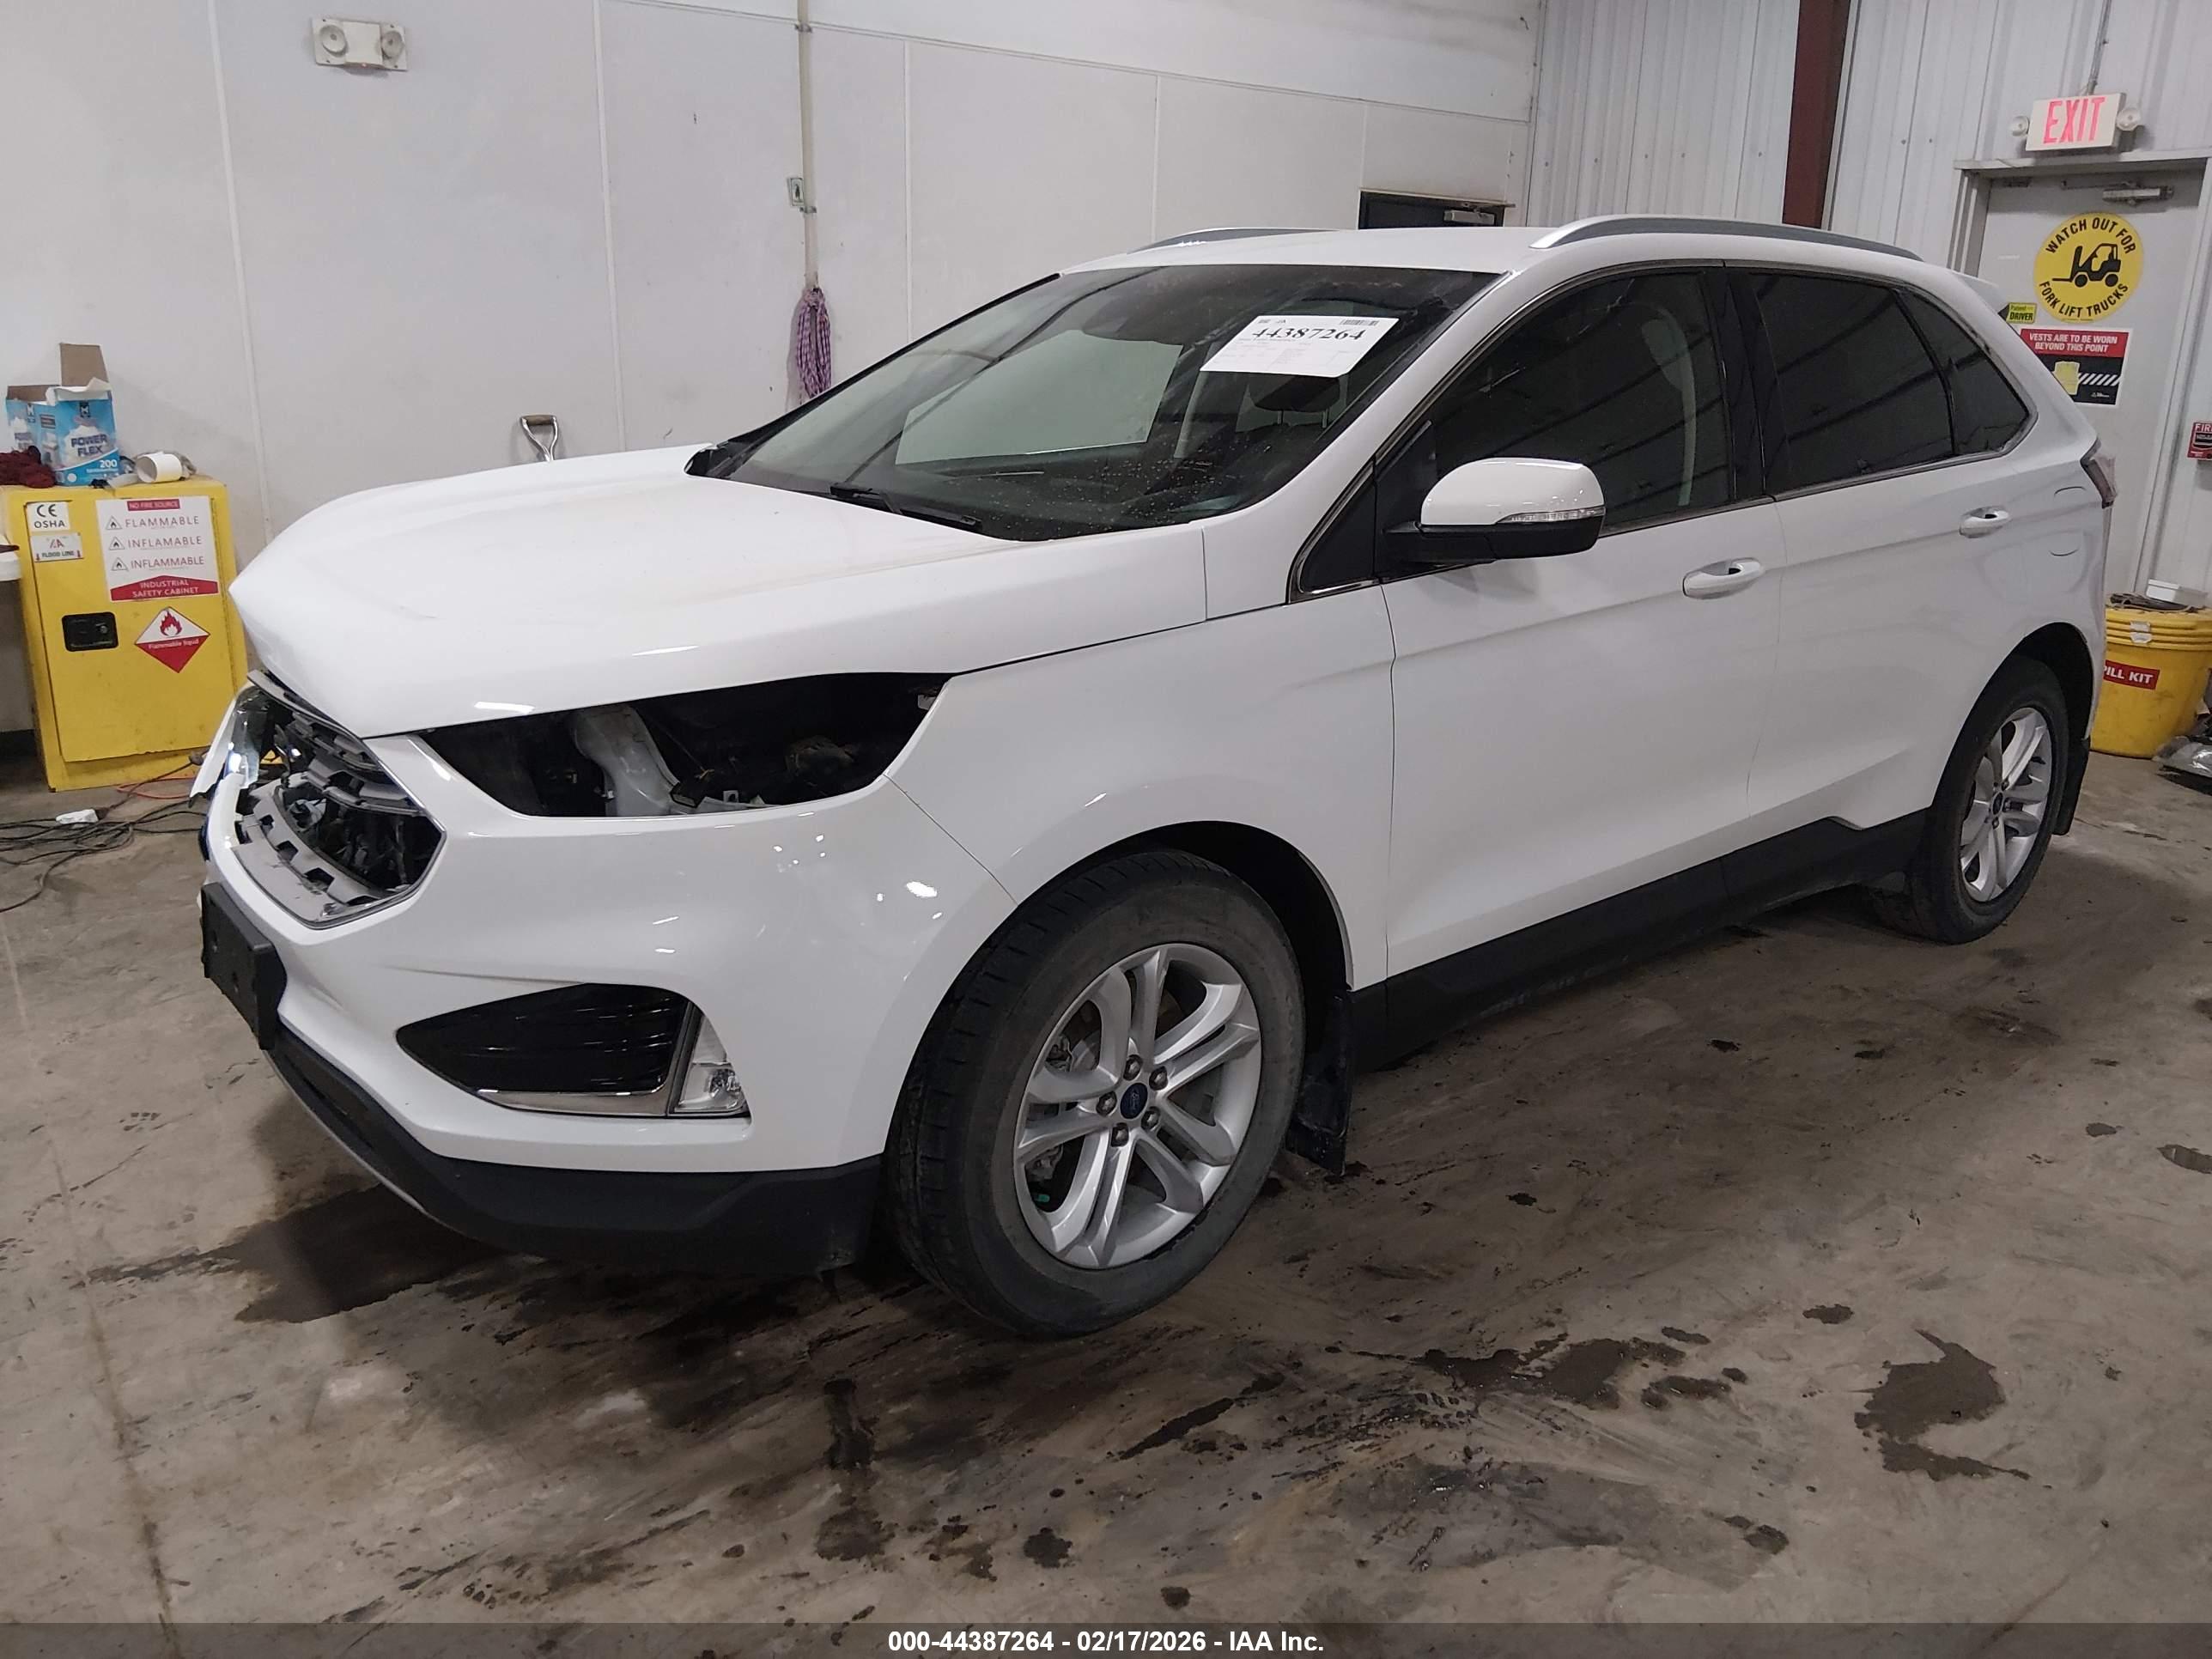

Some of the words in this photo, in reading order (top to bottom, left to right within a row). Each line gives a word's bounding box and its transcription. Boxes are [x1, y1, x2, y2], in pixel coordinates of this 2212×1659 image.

[2043, 96, 2106, 144] EXIT
[2045, 218, 2087, 253] WATCH
[2092, 216, 2118, 233] OUT
[2115, 228, 2136, 254] FOR
[2039, 281, 2061, 309] FORK
[2059, 302, 2083, 318] LIFT
[2086, 283, 2129, 317] TRUCKS
[2009, 312, 2033, 321] DRIVER
[1252, 327, 1367, 341] 44387264
[2029, 332, 2053, 342] VESTS
[2053, 334, 2069, 343] ARE
[2081, 335, 2092, 343] BE
[2093, 336, 2118, 344] WORN
[2034, 342, 2065, 351] BEYOND
[2067, 343, 2083, 352] THIS
[2084, 344, 2109, 353] POINT
[71, 434, 107, 447] POWER
[78, 446, 103, 457] FLEX
[100, 459, 118, 468] 200
[33, 520, 65, 529] OSHA
[125, 515, 200, 528] FLAMMABLE
[127, 535, 203, 548] INFLAMABLE
[131, 556, 205, 569] INFLAMMABLE
[140, 579, 189, 589] INDUSTRIAL
[131, 588, 162, 598] SAFETY
[163, 586, 200, 596] CABINET
[2129, 672, 2154, 684] KIT
